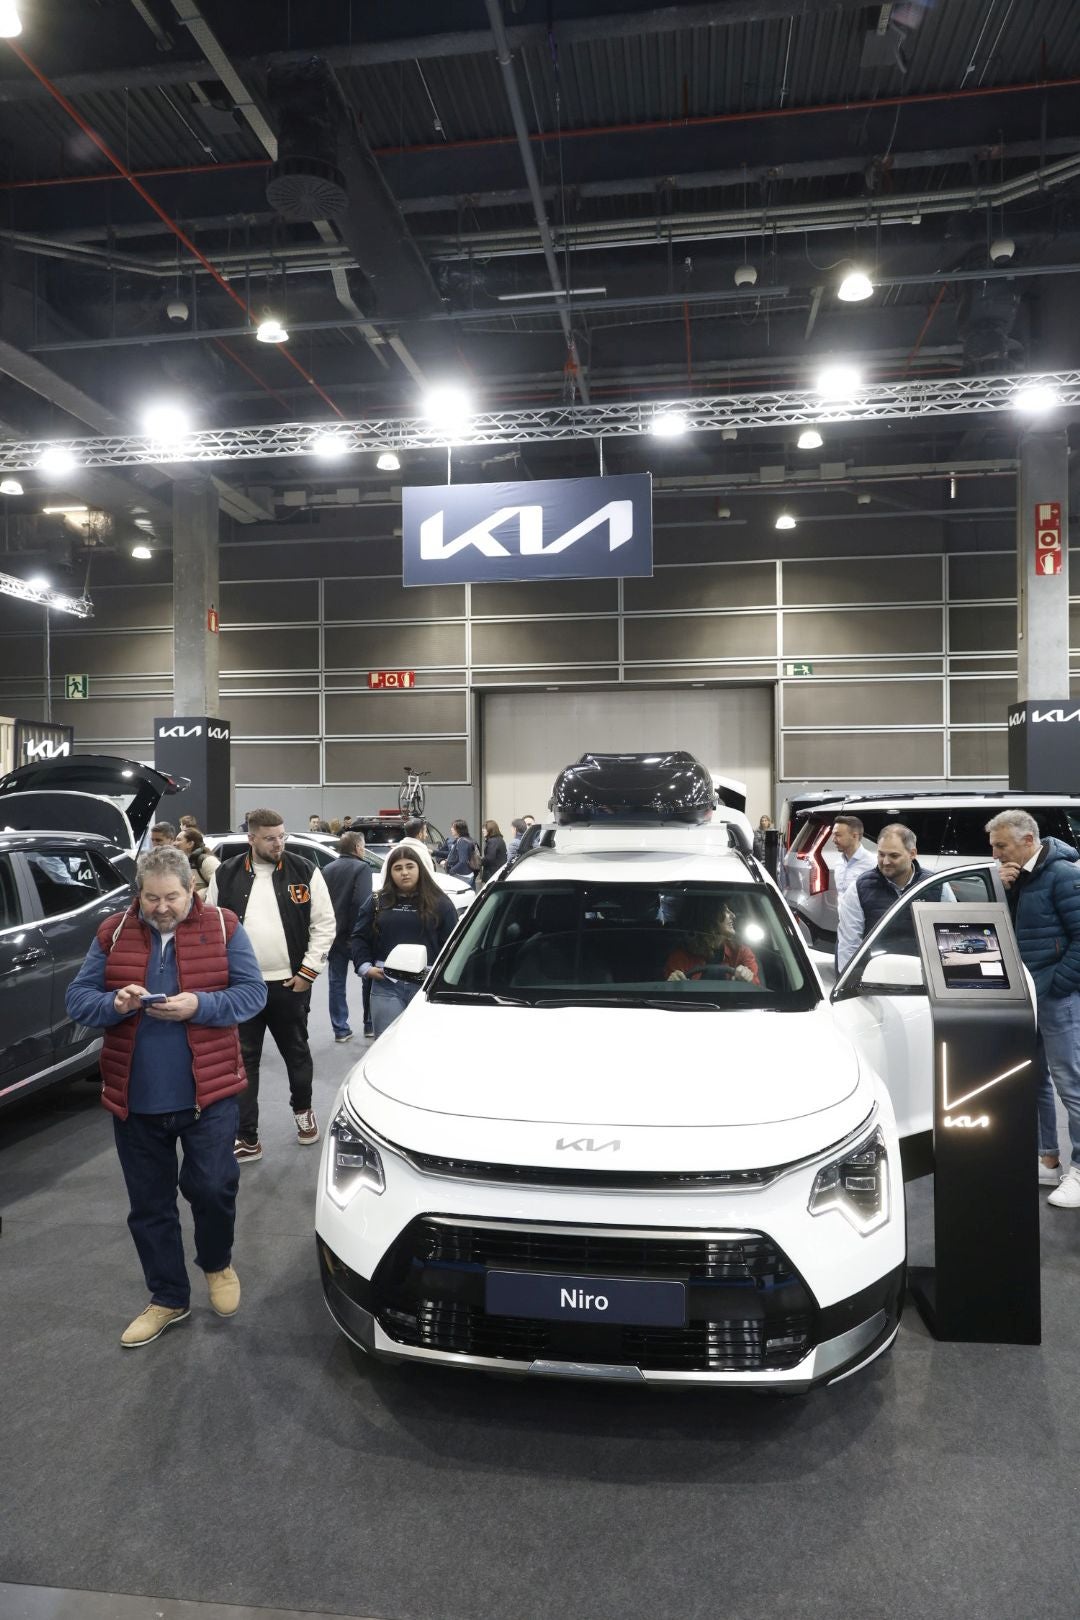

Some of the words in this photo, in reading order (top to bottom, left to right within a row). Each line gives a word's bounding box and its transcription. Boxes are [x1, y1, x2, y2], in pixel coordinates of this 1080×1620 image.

[420, 500, 633, 560] KIA
[1009, 711, 1026, 727] KIA
[159, 725, 202, 738] KIA
[208, 726, 230, 740] KIA
[26, 739, 70, 757] KIA
[943, 1115, 990, 1128] KIA
[555, 1137, 621, 1152] KIA
[560, 1288, 609, 1311] Niro
